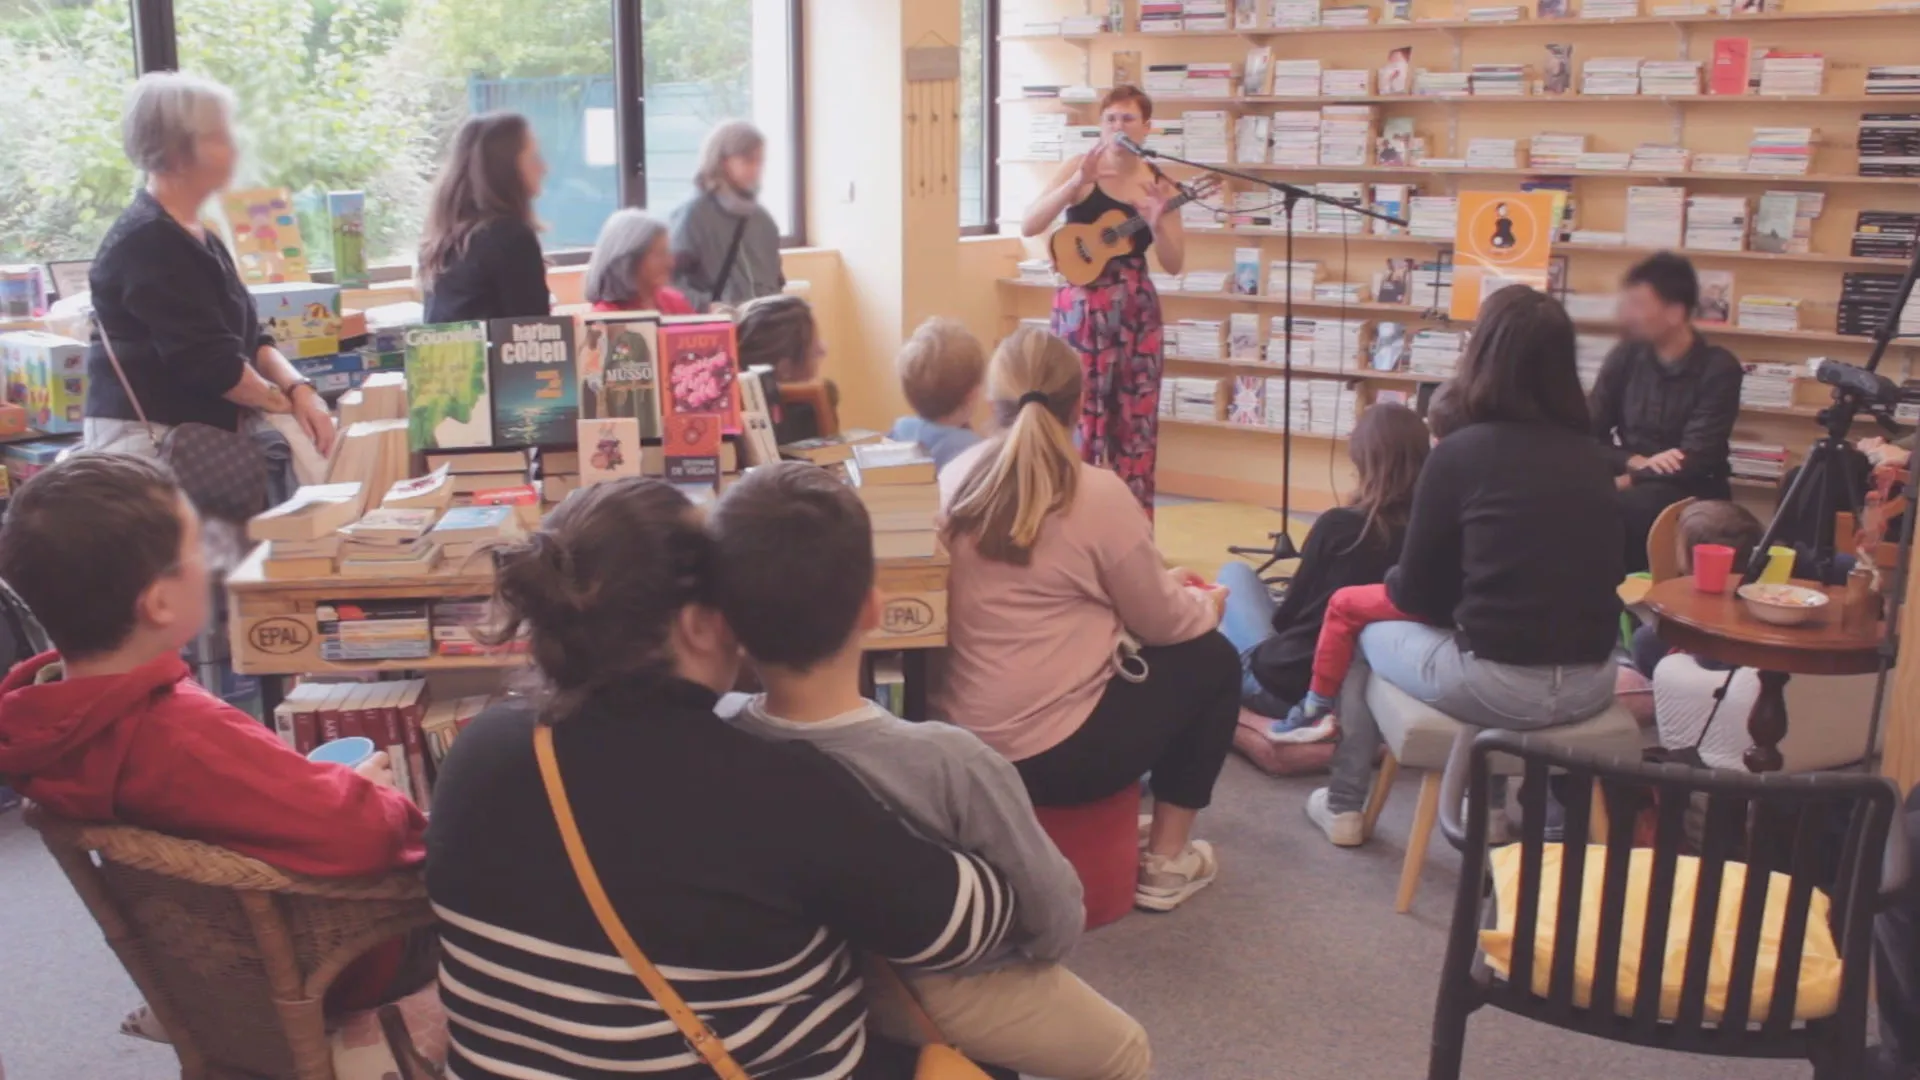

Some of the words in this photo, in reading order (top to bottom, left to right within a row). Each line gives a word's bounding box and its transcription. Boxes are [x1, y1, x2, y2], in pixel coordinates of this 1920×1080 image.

[606, 367, 653, 381] MUSSO
[885, 606, 924, 626] EPAL
[258, 627, 303, 647] EPAL
